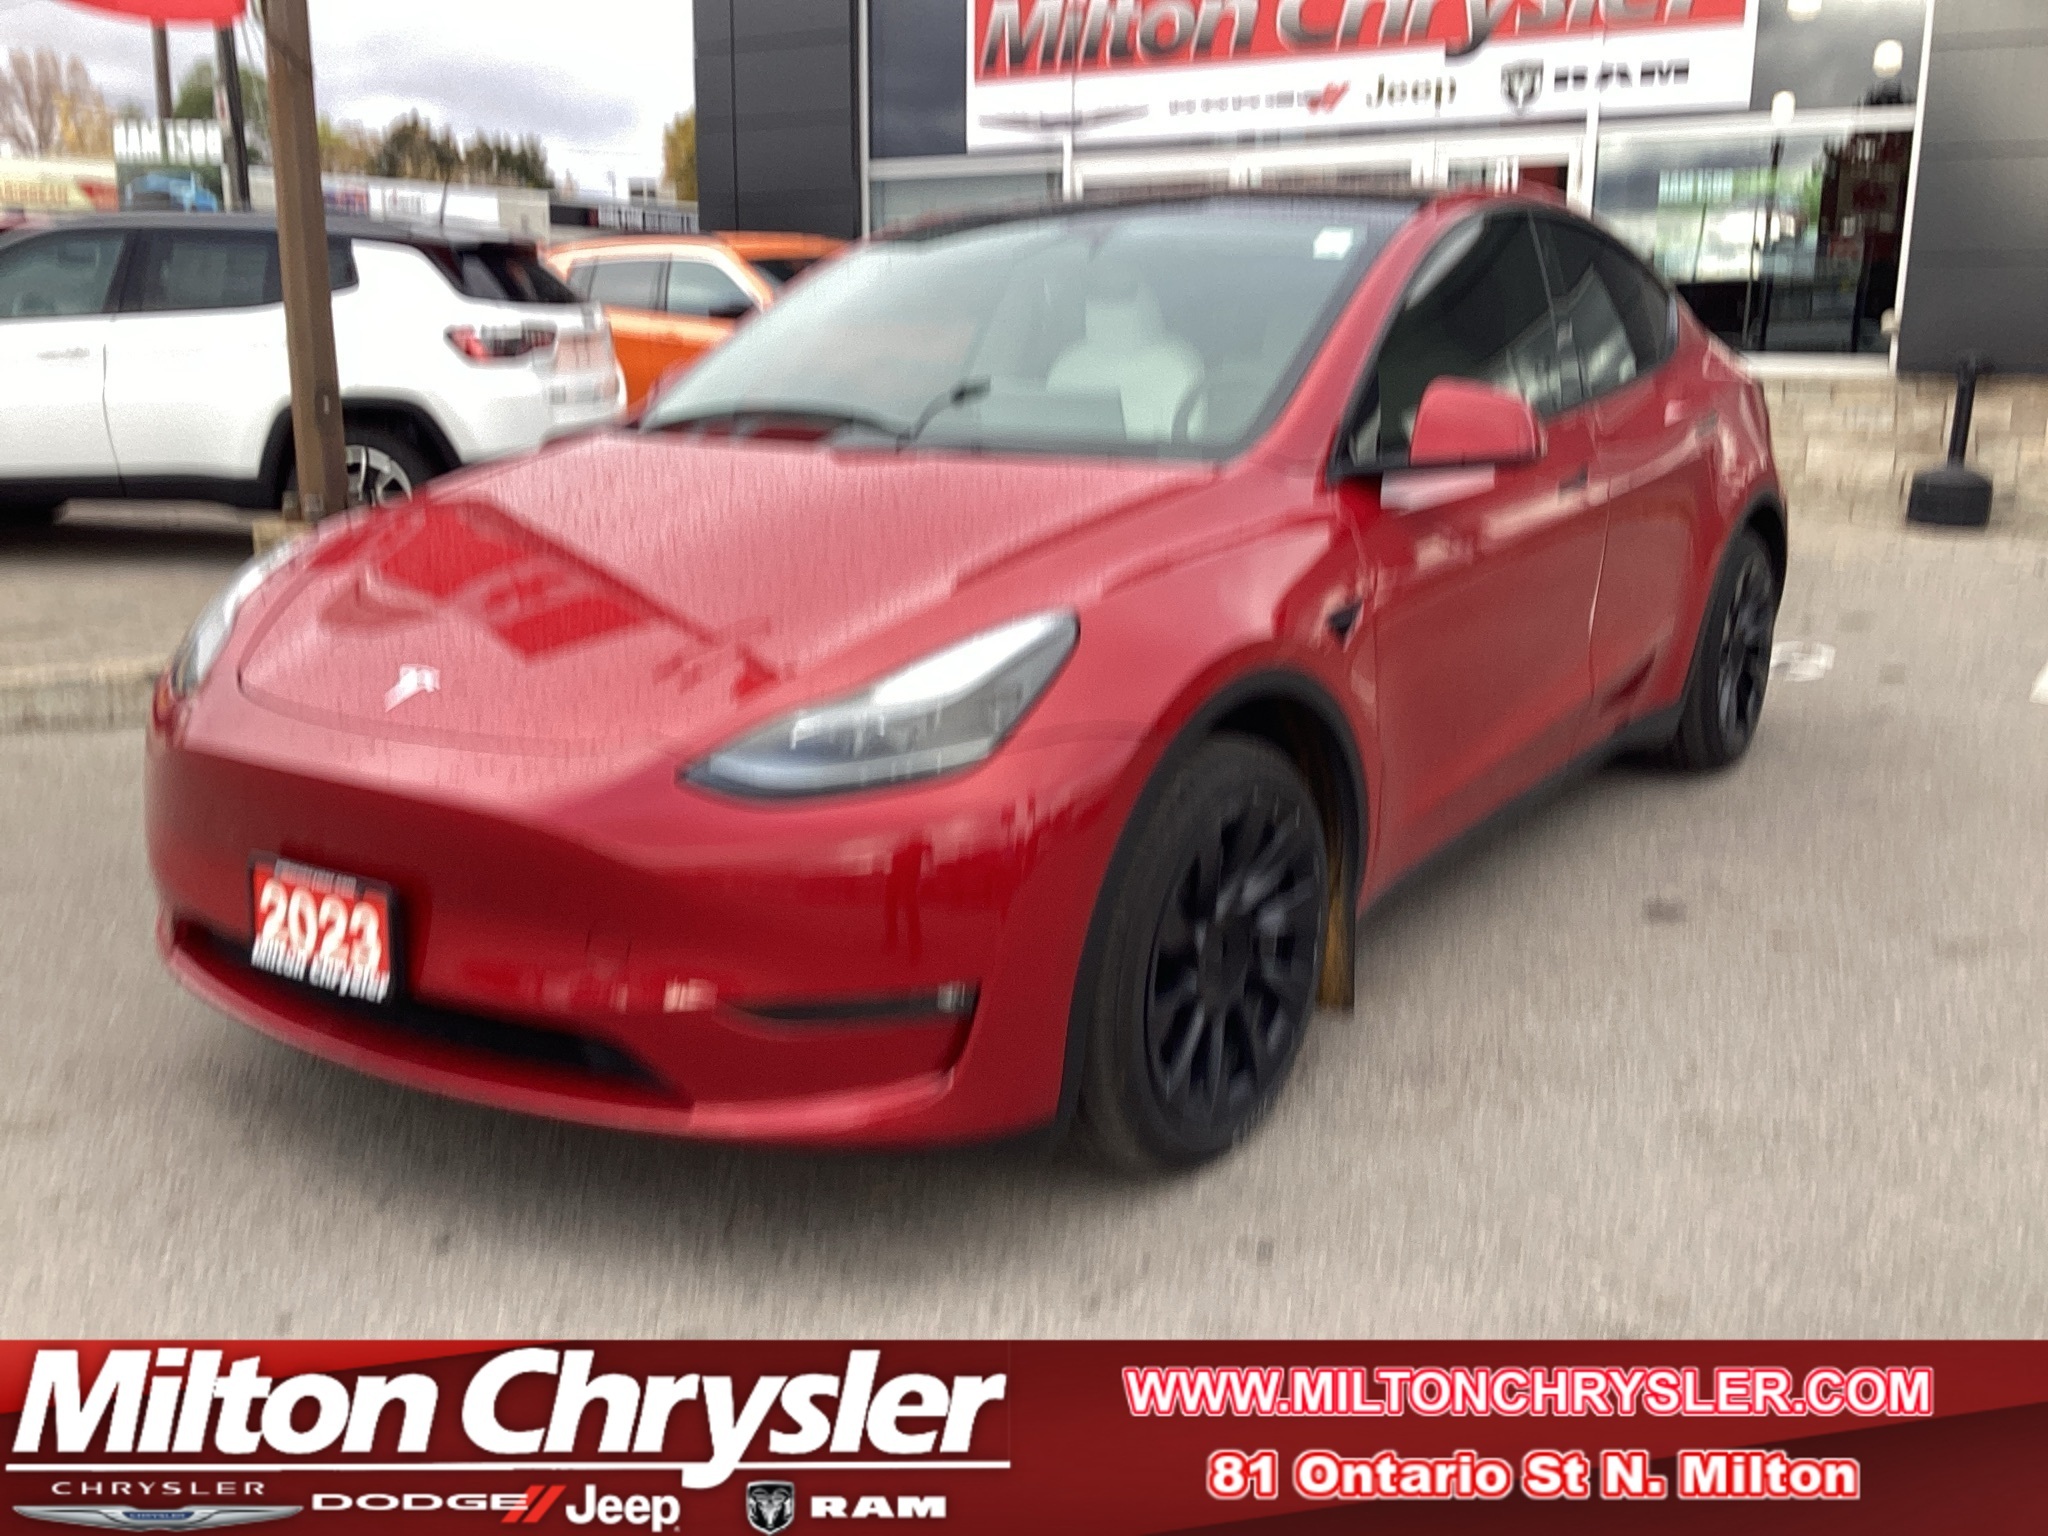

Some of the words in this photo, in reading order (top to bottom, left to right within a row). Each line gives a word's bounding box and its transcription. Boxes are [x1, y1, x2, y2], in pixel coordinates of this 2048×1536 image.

[978, 0, 1257, 77] Milton
[1366, 73, 1457, 117] Jeep
[259, 876, 382, 967] 2023
